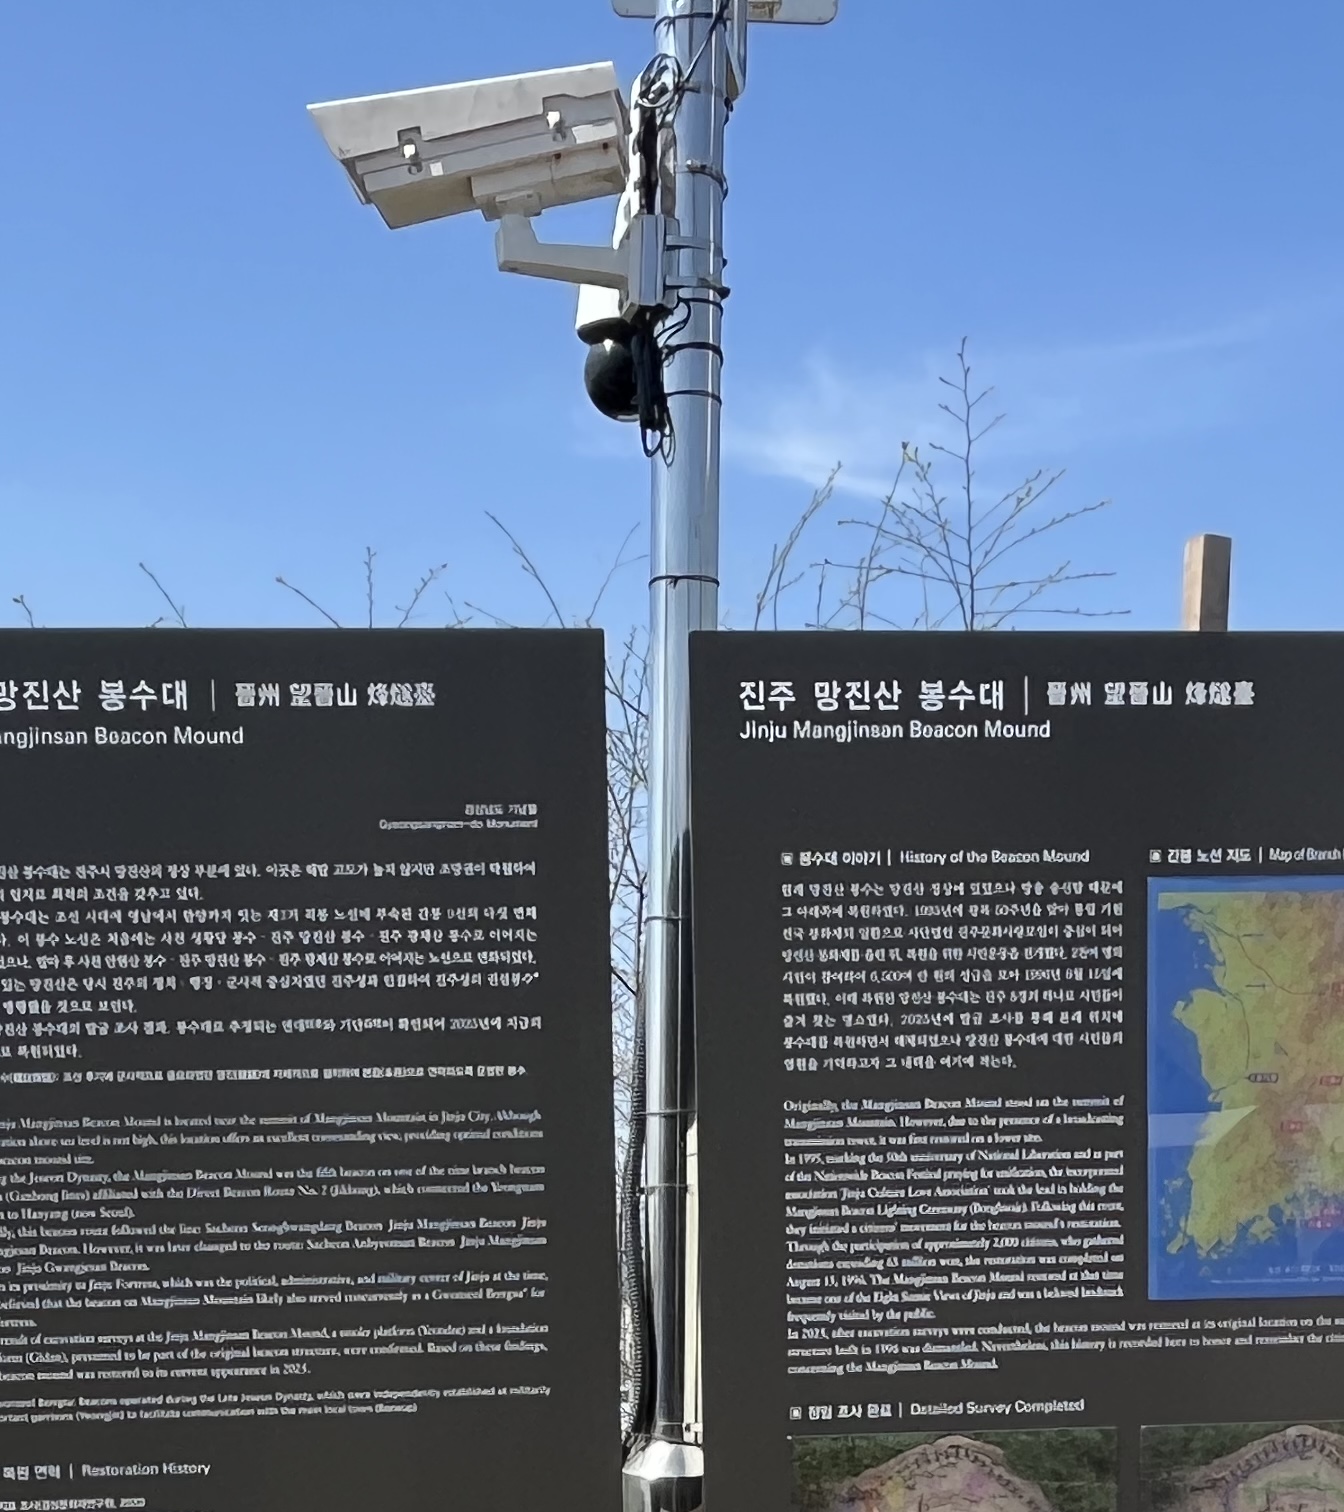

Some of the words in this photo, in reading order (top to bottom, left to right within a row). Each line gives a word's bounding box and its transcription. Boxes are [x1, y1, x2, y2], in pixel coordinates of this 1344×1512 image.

[97, 679, 187, 711] 봉수대
[738, 679, 796, 712] 진주
[813, 679, 902, 711] 망진산
[917, 679, 1004, 711] 봉수대
[94, 725, 167, 745] Beacon
[173, 725, 244, 745] Mound
[739, 719, 787, 743] Jinju
[792, 719, 903, 743] Mangjinsan
[909, 719, 978, 738] Beacon
[984, 719, 1050, 738] Mound
[799, 850, 838, 866] 봉수대
[841, 850, 881, 866] 이야기
[899, 849, 947, 866] History
[949, 849, 964, 863] of
[966, 850, 988, 863] the
[990, 849, 1040, 863] Beacon
[1042, 848, 1090, 863] Mound
[1196, 849, 1222, 863] 노선
[1226, 848, 1251, 862] 지도
[1269, 849, 1292, 863] Map
[17, 932, 29, 947] 이
[965, 1399, 1012, 1416] Survey
[1014, 1397, 1085, 1415] Completed
[81, 1461, 159, 1477] Restoration
[162, 1461, 211, 1476] History
